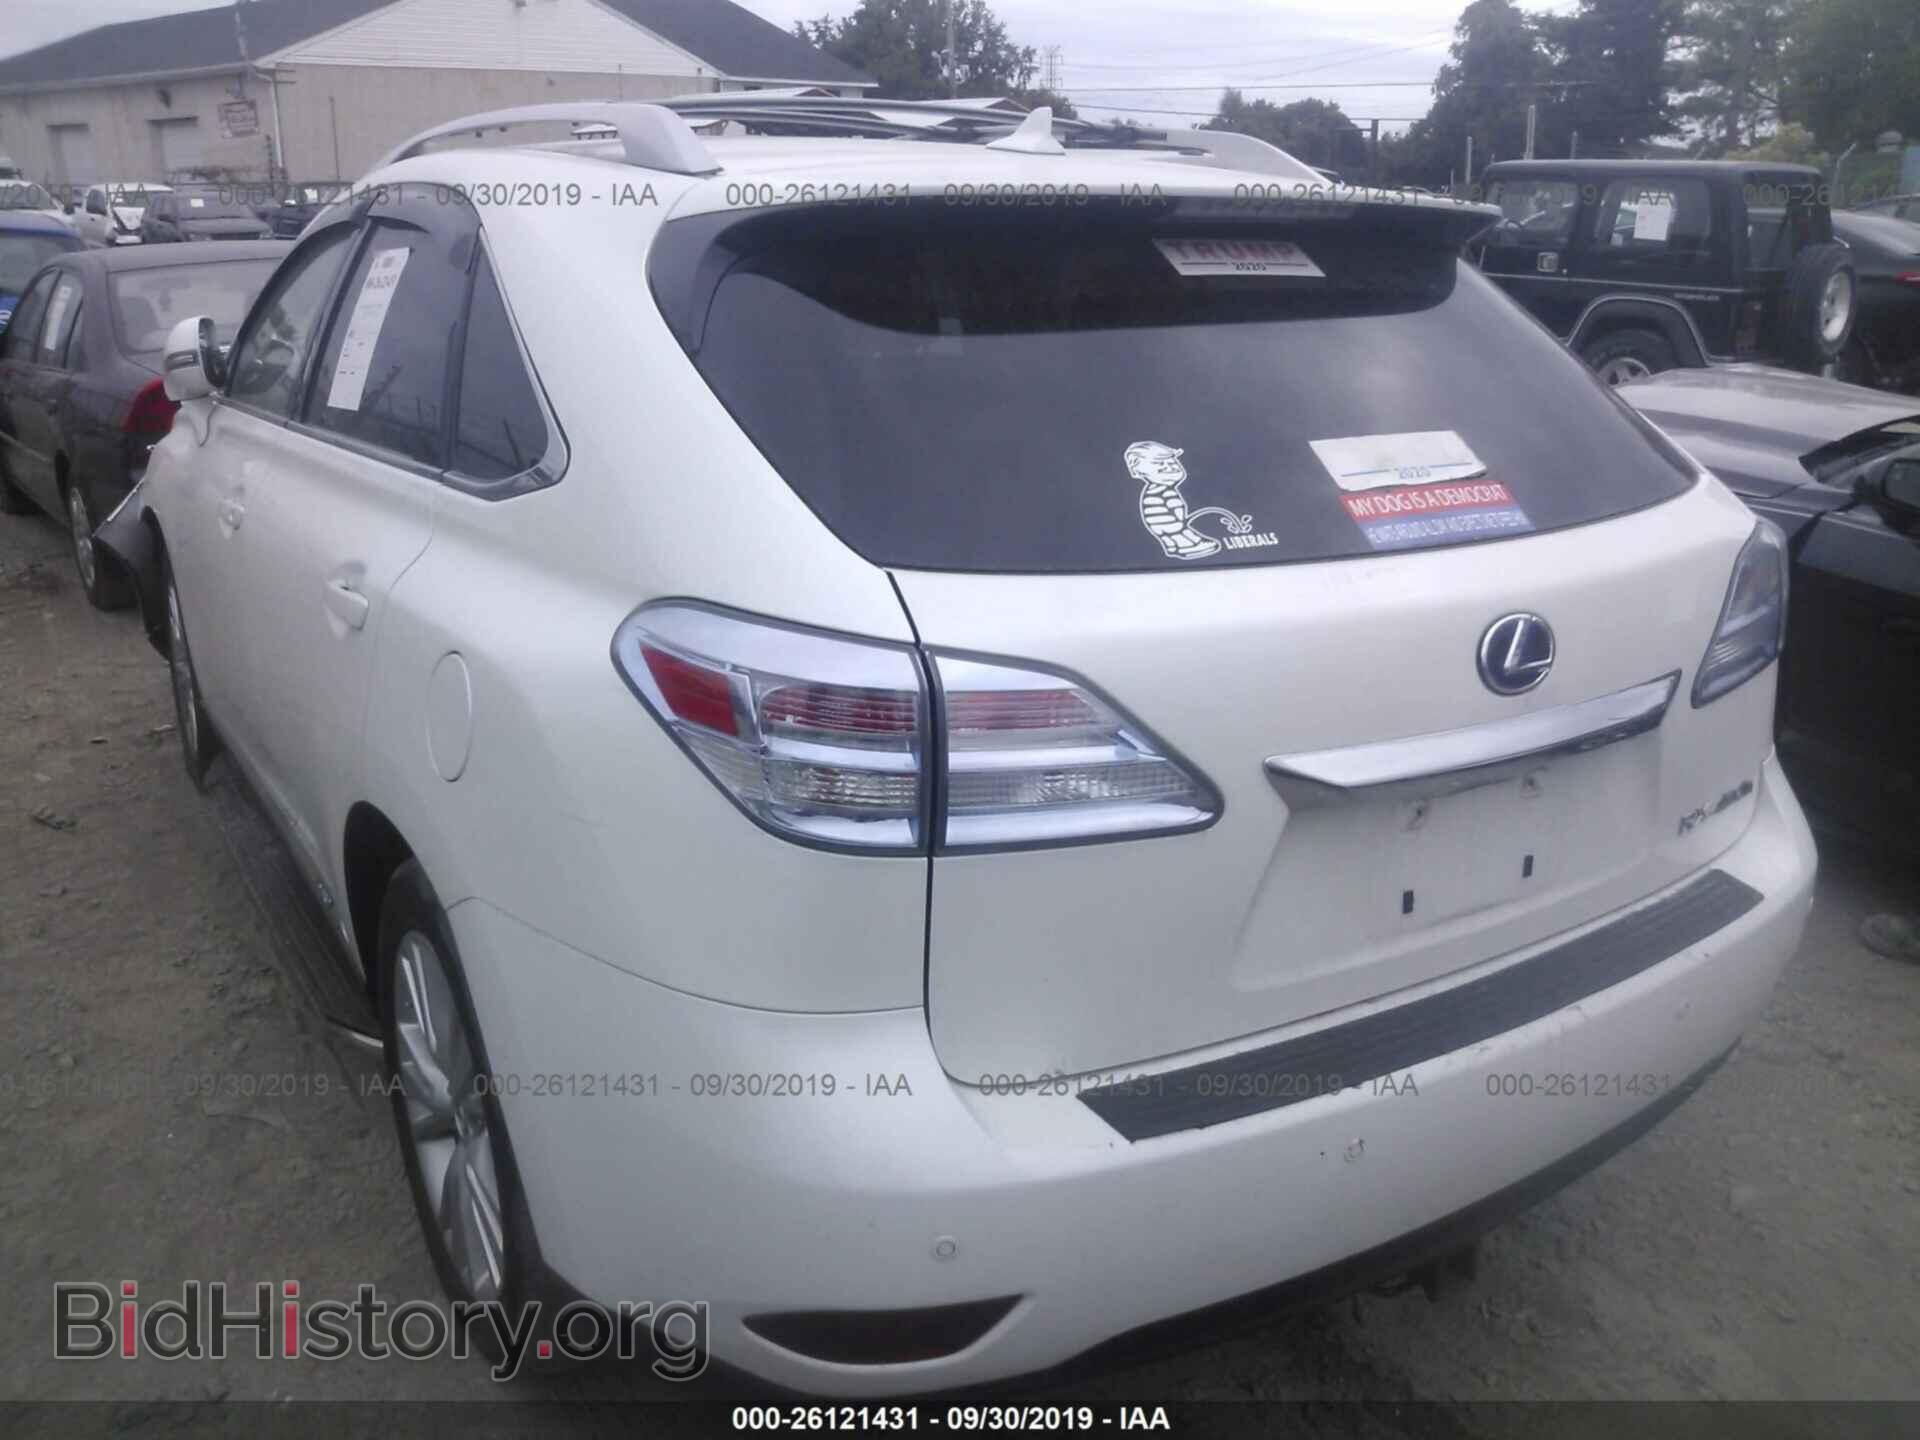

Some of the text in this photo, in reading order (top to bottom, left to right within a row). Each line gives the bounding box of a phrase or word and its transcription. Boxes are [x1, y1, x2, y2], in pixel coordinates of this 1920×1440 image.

[1347, 483, 1509, 517] MY DOG IS A DEMOCRAT
[1222, 532, 1280, 550] LIBERALS
